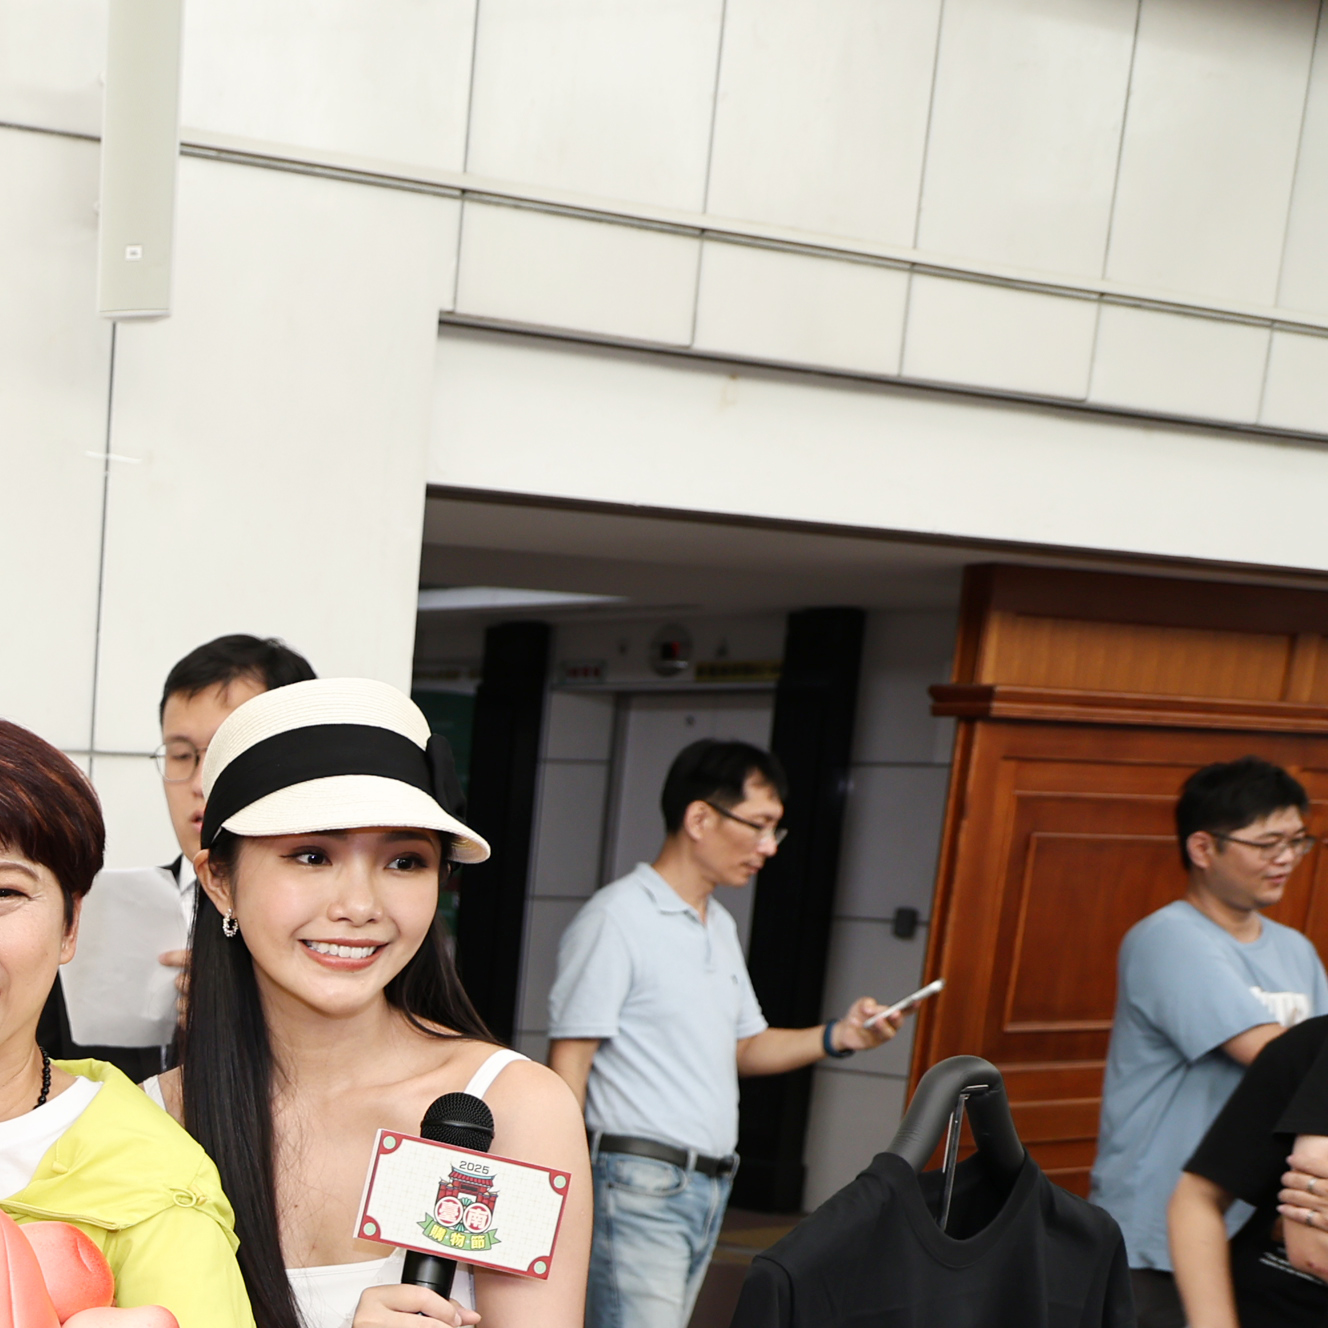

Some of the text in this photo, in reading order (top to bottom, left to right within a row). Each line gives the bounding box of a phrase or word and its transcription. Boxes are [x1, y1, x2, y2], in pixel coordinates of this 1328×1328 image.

[459, 1160, 491, 1175] 2025
[428, 1223, 487, 1249] 購物節
